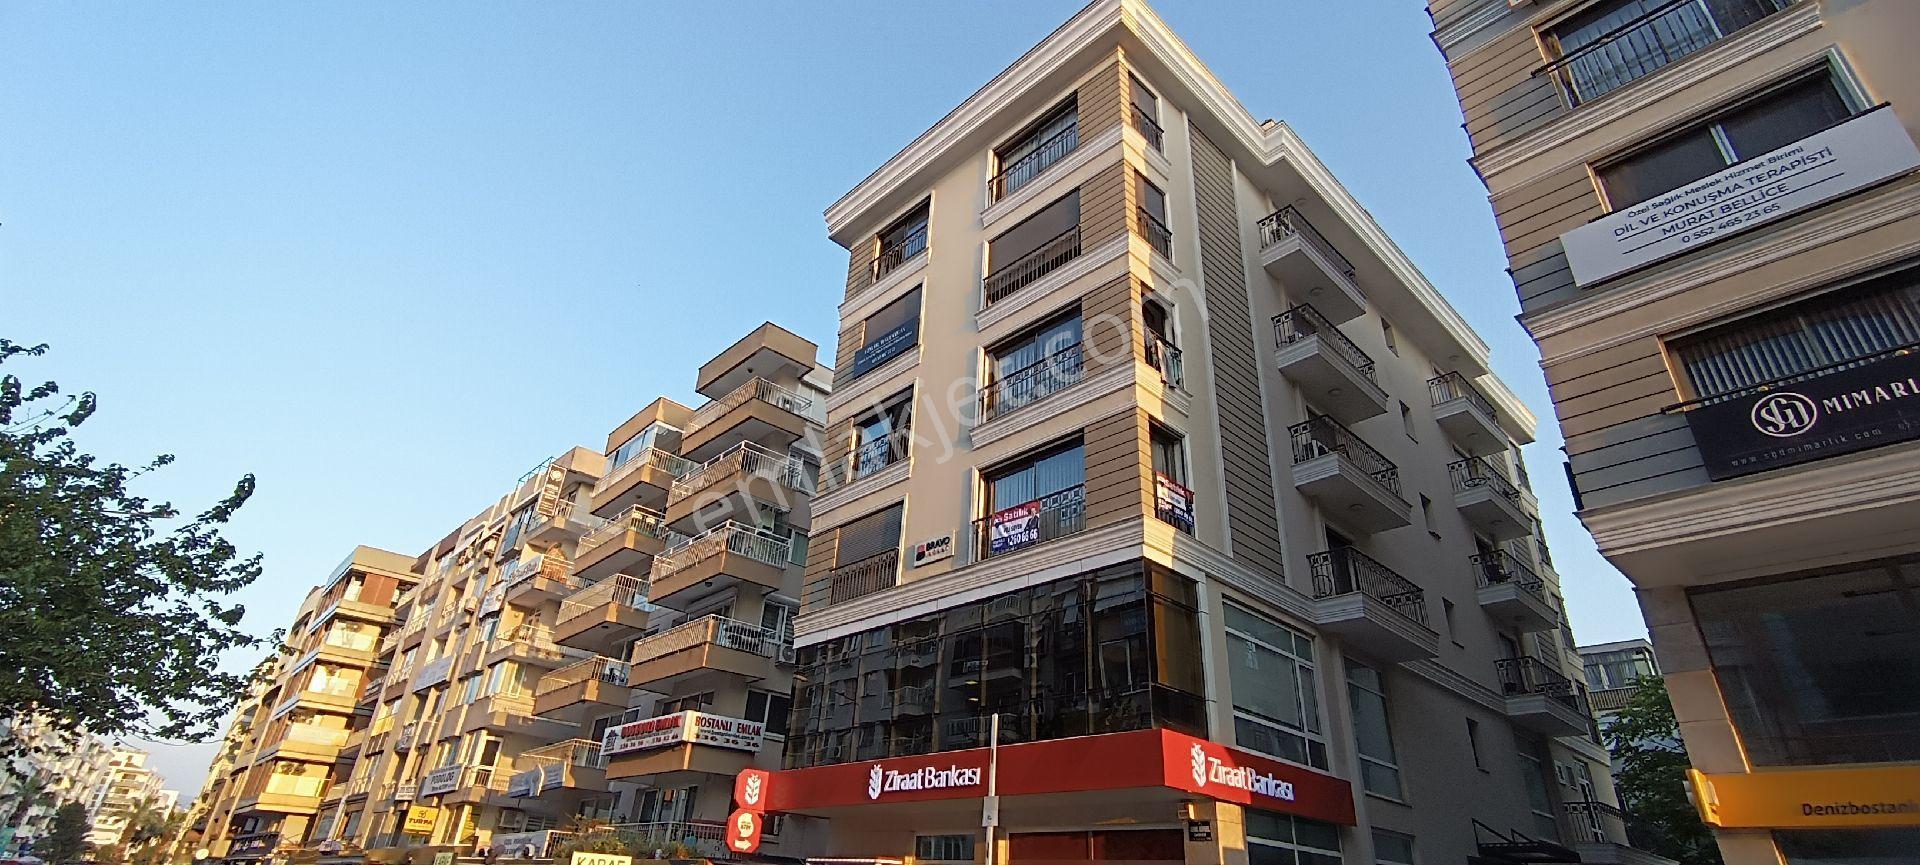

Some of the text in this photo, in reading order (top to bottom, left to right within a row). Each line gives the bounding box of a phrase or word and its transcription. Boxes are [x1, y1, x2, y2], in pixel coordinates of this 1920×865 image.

[1614, 146, 1833, 236] DİL VE KONUŞMA TERAPİSTİ
[1684, 177, 1722, 196] Meslek
[1724, 161, 1766, 180] Hizmet
[1662, 183, 1789, 235] MURAT BELLİCE
[1682, 202, 1780, 243] 0 552 465 23 65
[925, 536, 951, 552] BRAVO
[695, 715, 762, 737] BOSTANLI EMLAK
[883, 764, 981, 792] Ziraat Bankası
[1208, 756, 1295, 801] Ziraat Bankası
